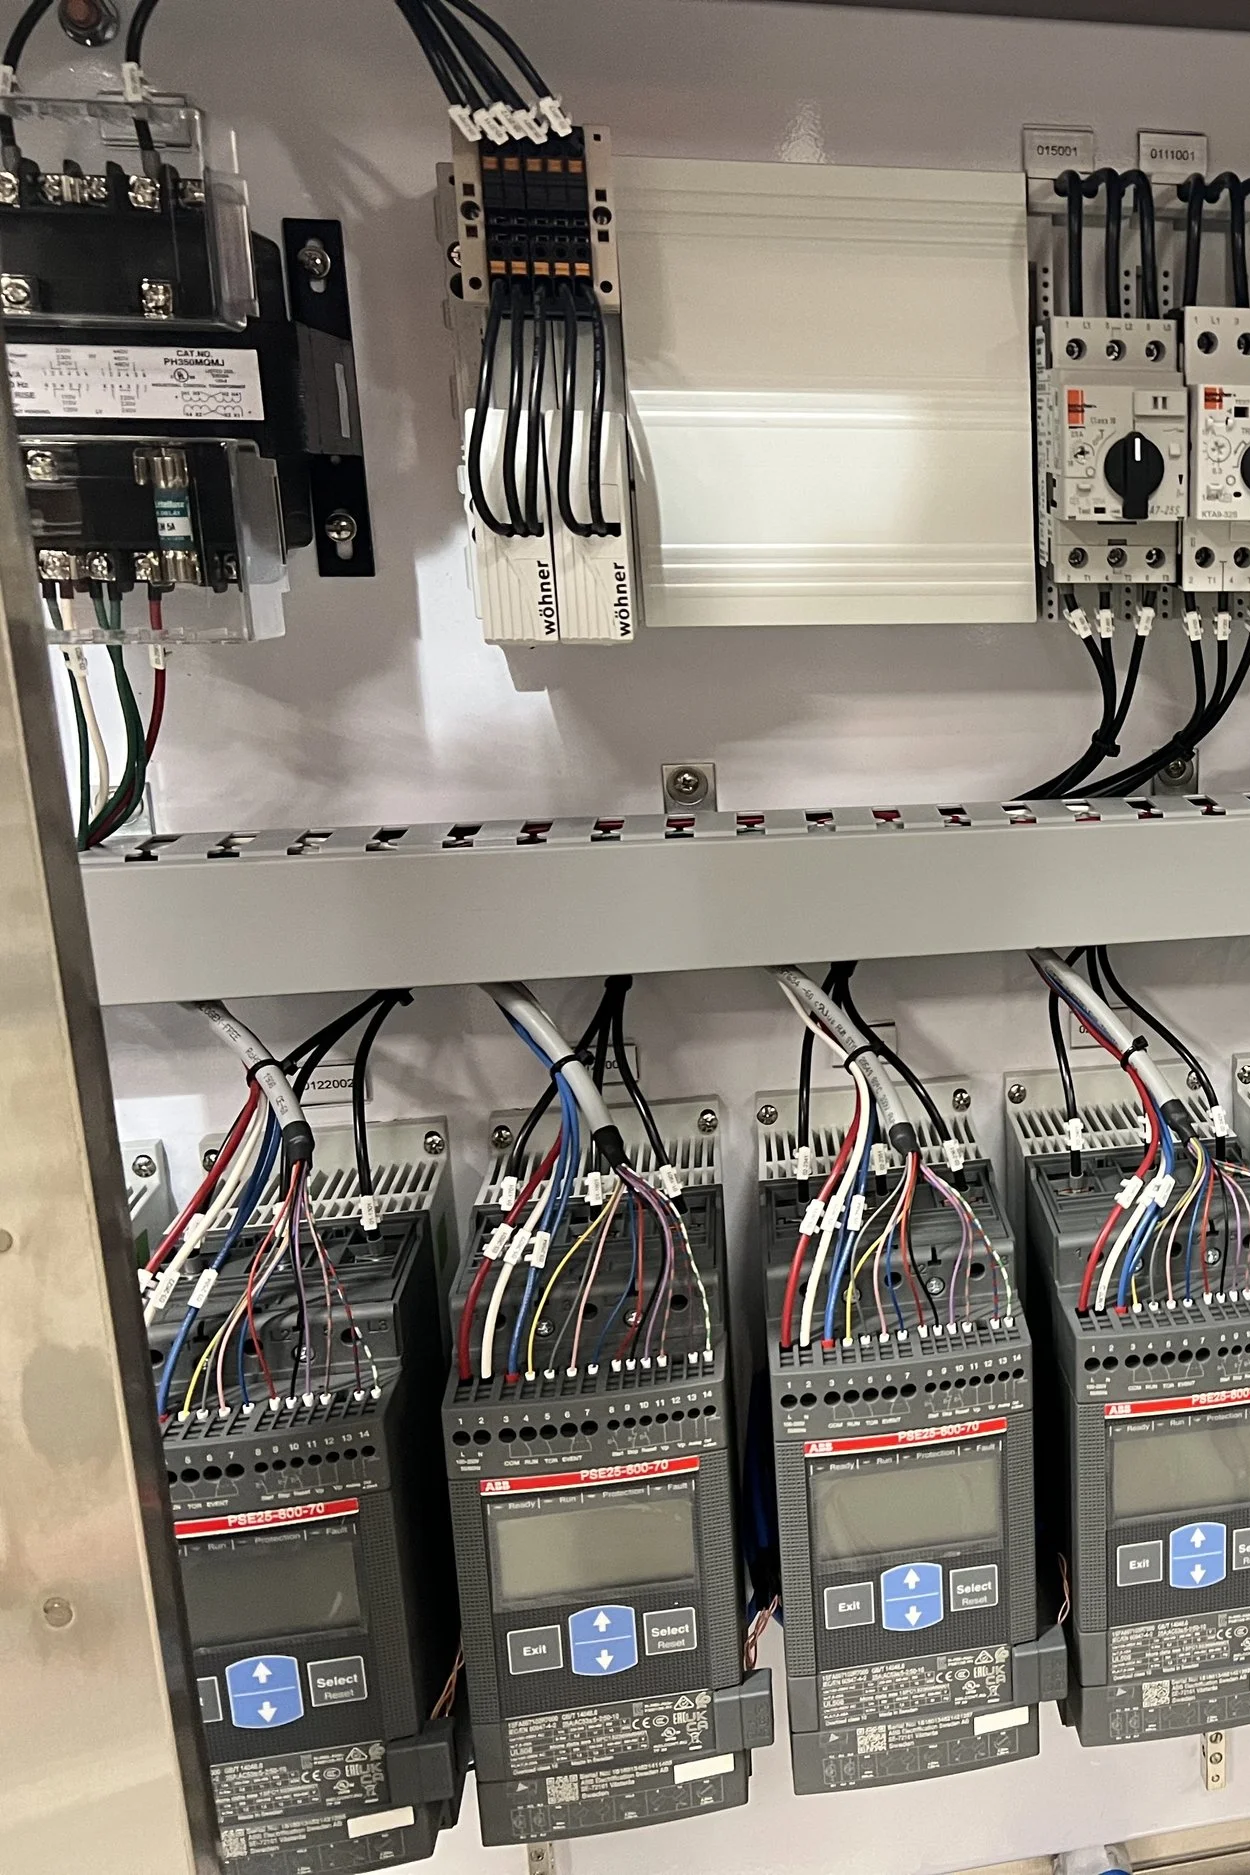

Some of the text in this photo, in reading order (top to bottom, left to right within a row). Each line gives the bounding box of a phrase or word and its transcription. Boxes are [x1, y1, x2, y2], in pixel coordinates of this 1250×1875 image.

[1037, 145, 1077, 157] 015001
[1150, 149, 1195, 161] 0111001
[164, 357, 225, 367] PH350MQMJ
[537, 561, 557, 635] wöhner
[613, 562, 632, 637] wöhner
[1109, 1344, 1114, 1352] 2
[1166, 1340, 1171, 1348] 5
[1234, 1332, 1239, 1340] 9
[886, 1374, 892, 1382] 6
[970, 1362, 978, 1370] 11
[458, 1417, 463, 1426] 1
[639, 1401, 649, 1409] 10
[656, 1399, 664, 1407] 11
[671, 1396, 681, 1404] 12
[703, 1390, 712, 1398] 14
[1109, 1405, 1131, 1414] ABB
[1207, 1411, 1243, 1422] Protection
[185, 1456, 191, 1464] 5
[206, 1454, 213, 1462] 6
[228, 1451, 234, 1459] 7
[255, 1448, 261, 1456] 8
[289, 1443, 299, 1451] 10
[307, 1440, 316, 1448] 11
[324, 1437, 334, 1445] 12
[342, 1434, 352, 1442] 13
[359, 1430, 370, 1438] 14
[809, 1443, 833, 1453] ABB
[830, 1444, 995, 1472] Ready Run Protection Fault
[485, 1480, 510, 1492] ABB
[508, 1482, 688, 1511] Ready Run Protection Fault
[208, 1526, 348, 1551] Run Protection Fault
[1129, 1560, 1150, 1570] Exit
[839, 1581, 992, 1613] Exit Select
[962, 1595, 988, 1606] Reset
[523, 1624, 689, 1657] Exit Select
[658, 1639, 685, 1649] Reset
[317, 1674, 358, 1689] Select
[324, 1689, 354, 1700] Reset
